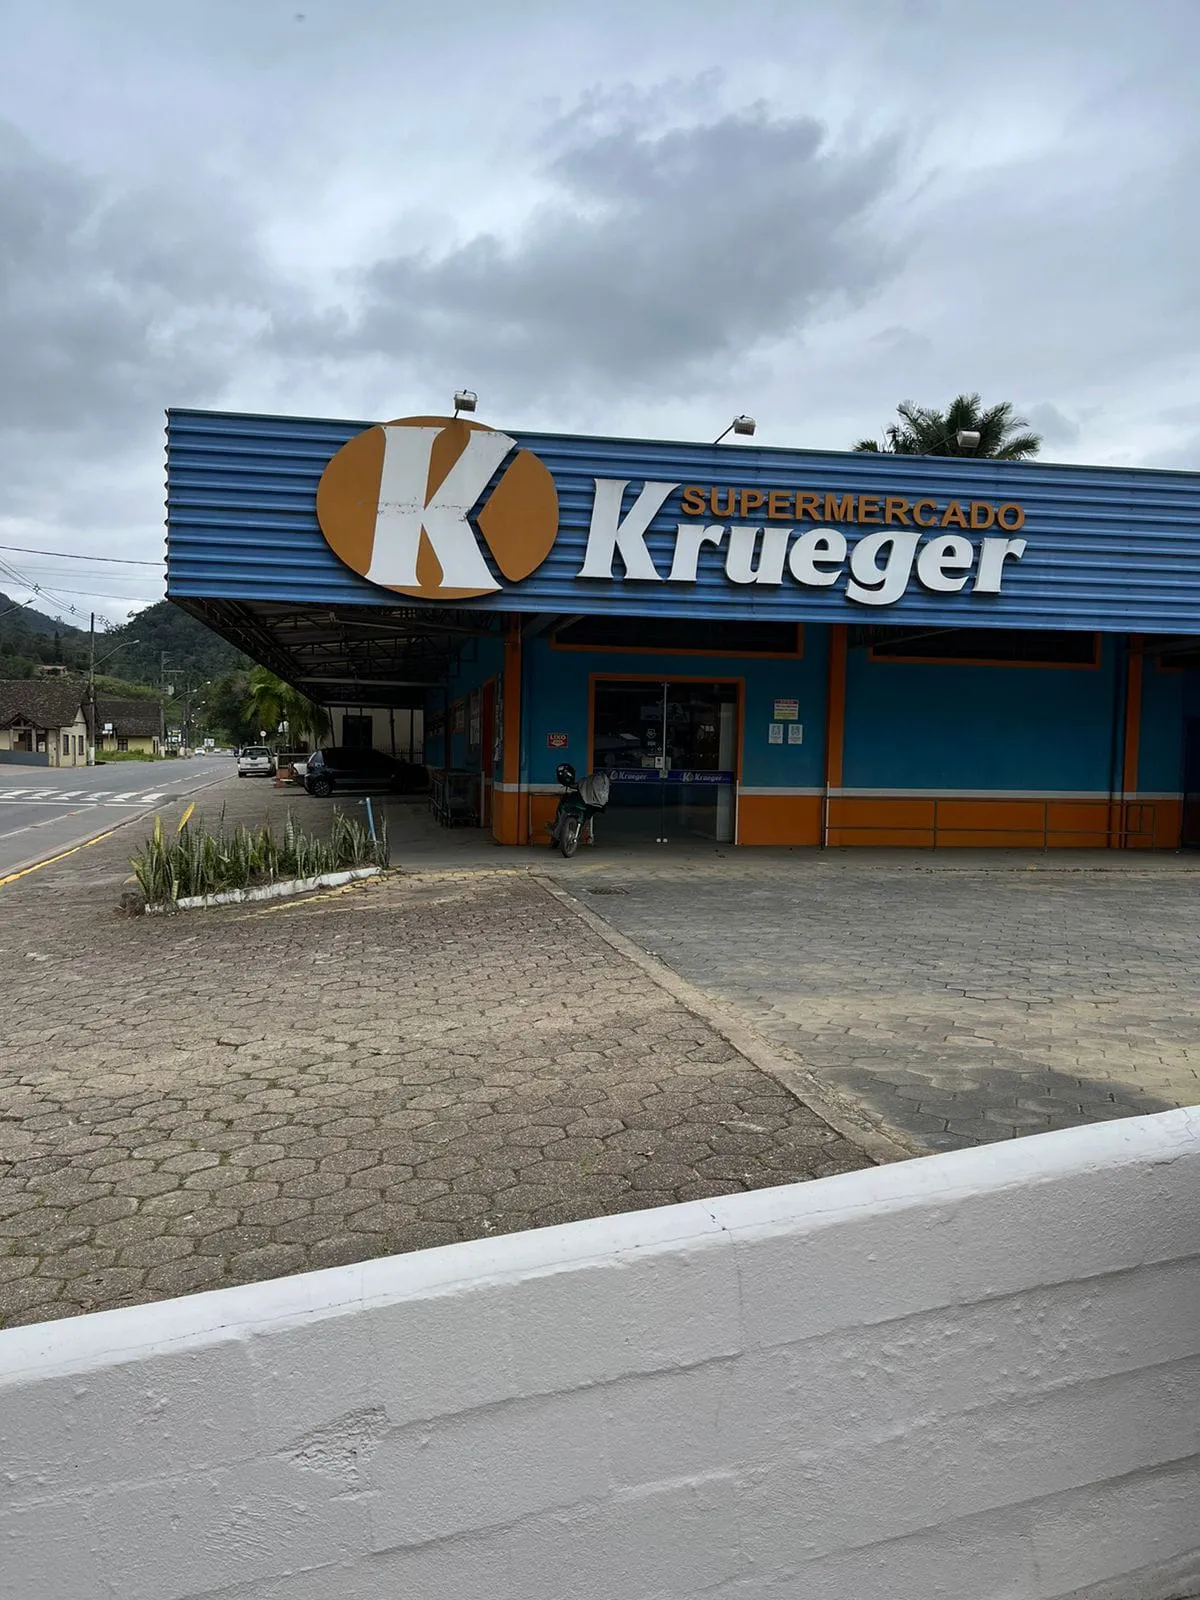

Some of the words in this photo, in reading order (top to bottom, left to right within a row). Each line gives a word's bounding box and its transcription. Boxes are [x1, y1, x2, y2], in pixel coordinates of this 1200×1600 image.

[364, 426, 518, 590] K
[576, 477, 1027, 606] Krueger
[681, 487, 1026, 532] SUPERMERCADO
